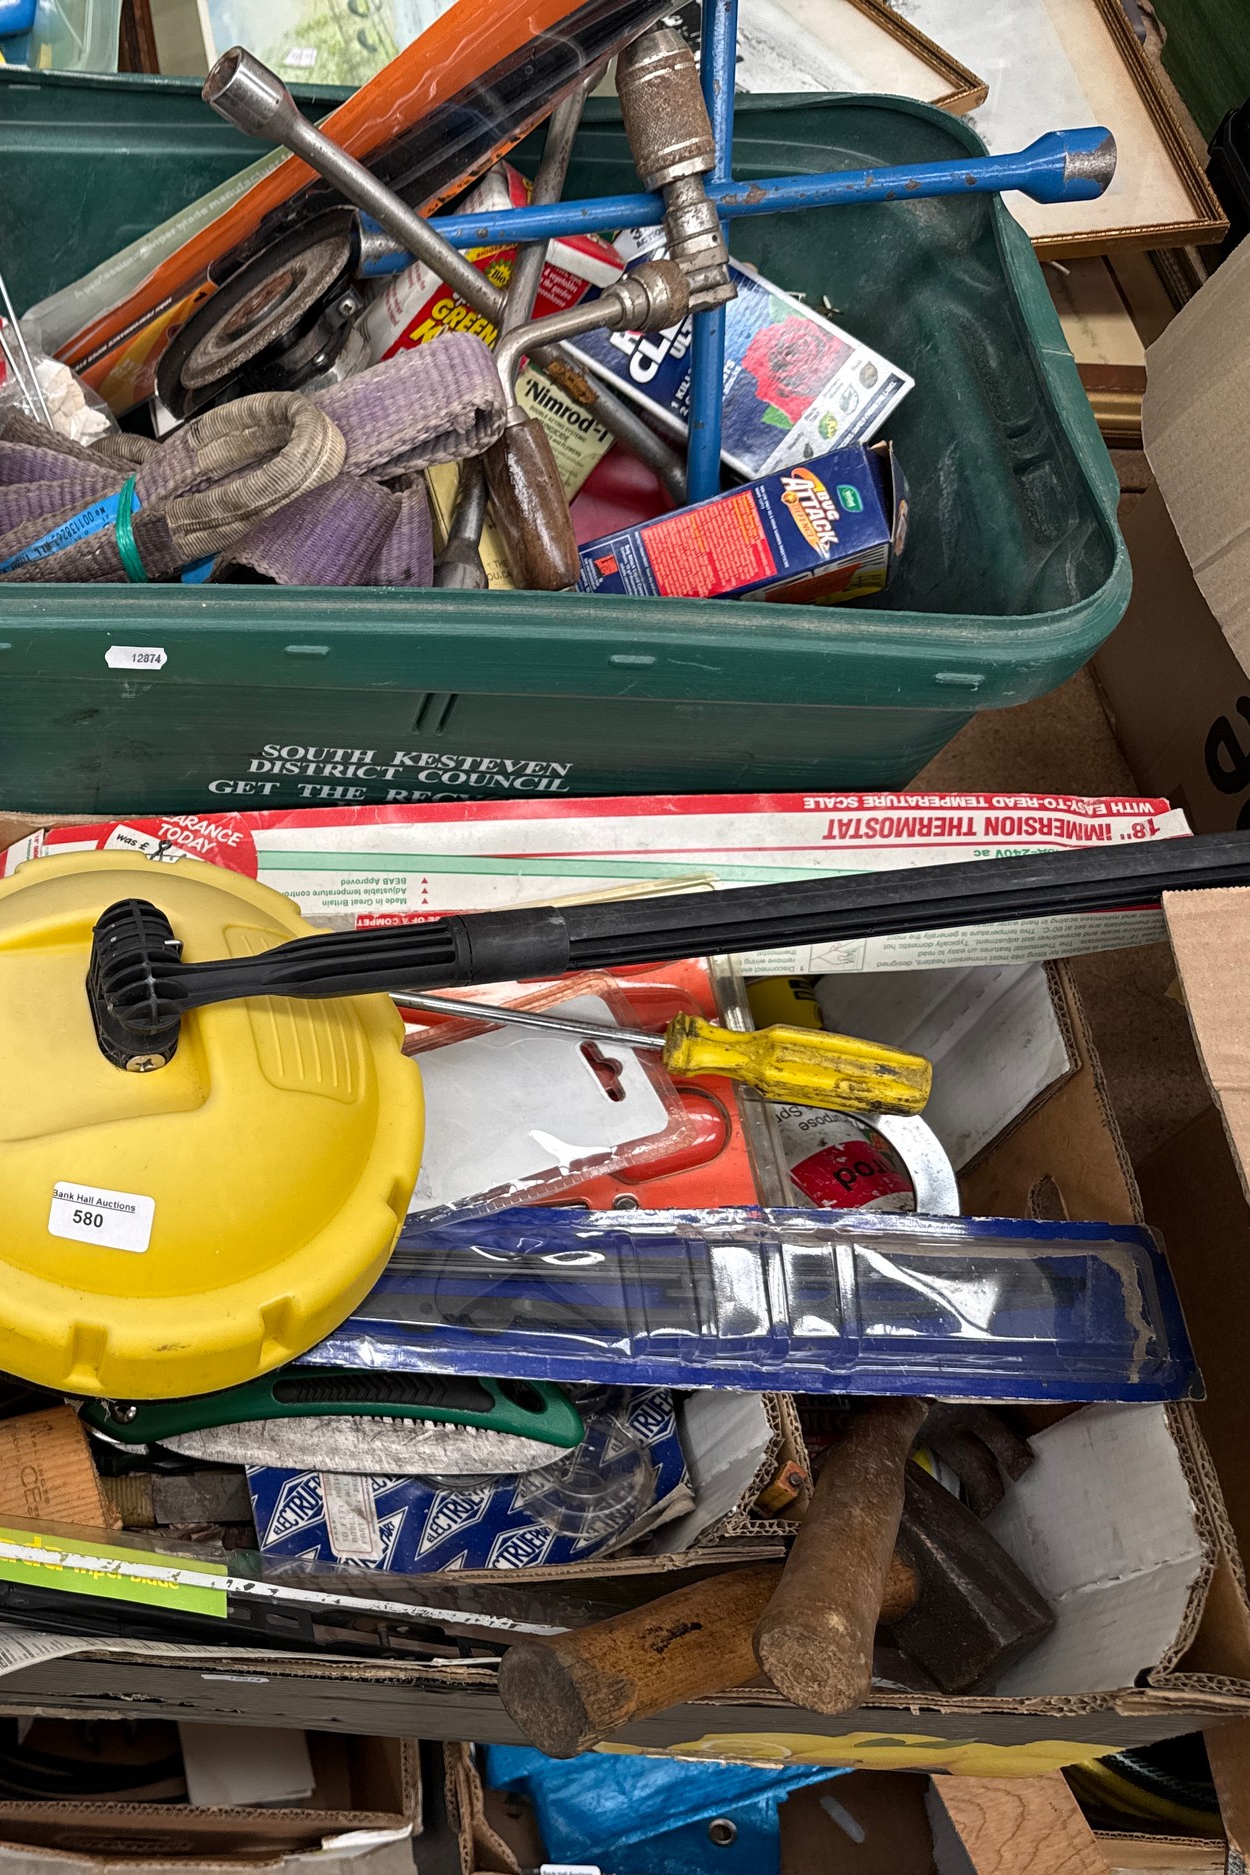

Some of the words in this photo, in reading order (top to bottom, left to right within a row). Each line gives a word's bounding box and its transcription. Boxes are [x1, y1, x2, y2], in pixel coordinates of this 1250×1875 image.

[779, 467, 839, 552] ATTACK
[815, 489, 840, 524] BUG
[131, 652, 162, 665] 12874
[262, 743, 377, 764] SOUTH
[390, 749, 574, 778] KESTEVEN
[247, 758, 403, 781] DISTRICT
[416, 767, 571, 793] COUNCIL
[208, 780, 280, 796] GET
[297, 783, 366, 802] THE
[802, 793, 859, 810] SCALE
[863, 792, 988, 812] TEMPERATURE
[991, 794, 1103, 816] EASY-TO-READ
[1111, 800, 1153, 814] WITH
[824, 811, 975, 842] THERMOSTAT
[983, 812, 1111, 843] IMMERSION
[115, 832, 137, 847] was
[139, 841, 150, 851] £
[157, 823, 217, 853] TODAY
[973, 849, 990, 858] ac
[340, 876, 380, 885] Approved
[382, 876, 406, 884] BEAB
[312, 887, 361, 896] temperature
[363, 886, 406, 895] Adjustable
[321, 898, 348, 906] Britain
[375, 897, 382, 905] in
[385, 897, 406, 905] Made
[356, 917, 398, 926] COMPET
[920, 929, 957, 941] generally
[968, 927, 1017, 939] temperature
[1018, 927, 1035, 936] This
[1036, 931, 1080, 941] screwdriver
[906, 933, 919, 941] the
[973, 935, 1019, 947] adjustment.
[882, 942, 896, 952] hot
[897, 941, 933, 950] domestic
[934, 938, 969, 949] Typically
[1013, 942, 1056, 951] Thermostat
[917, 950, 931, 959] read
[943, 946, 963, 956] easy
[979, 945, 1012, 954] features
[744, 956, 765, 966] wiring
[768, 956, 795, 965] remove
[914, 956, 944, 965] heaters,
[946, 954, 987, 965] immersion
[989, 953, 1008, 961] most
[1010, 952, 1025, 960] into
[876, 958, 912, 968] designed
[754, 964, 794, 973] Disconnect
[75, 1192, 94, 1204] Hall
[95, 1197, 136, 1213] Auctions
[71, 1208, 104, 1228] 580
